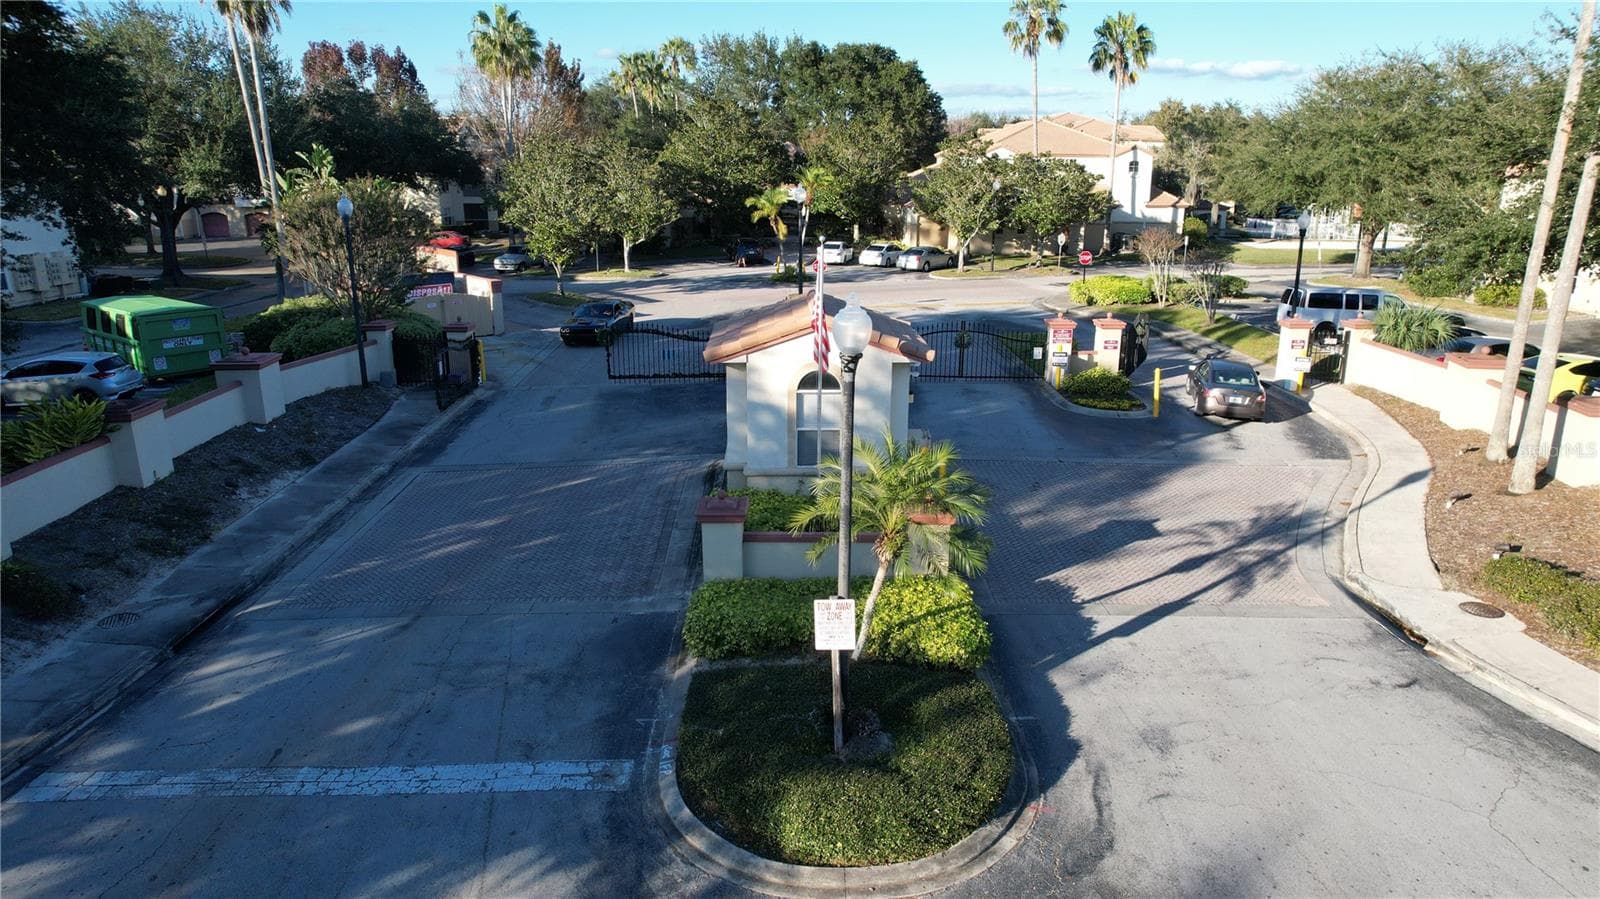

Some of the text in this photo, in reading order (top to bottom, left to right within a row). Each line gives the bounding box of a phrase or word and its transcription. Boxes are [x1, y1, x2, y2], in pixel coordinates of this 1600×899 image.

[817, 602, 852, 611] TOW AWAY
[827, 611, 843, 621] ZONE
